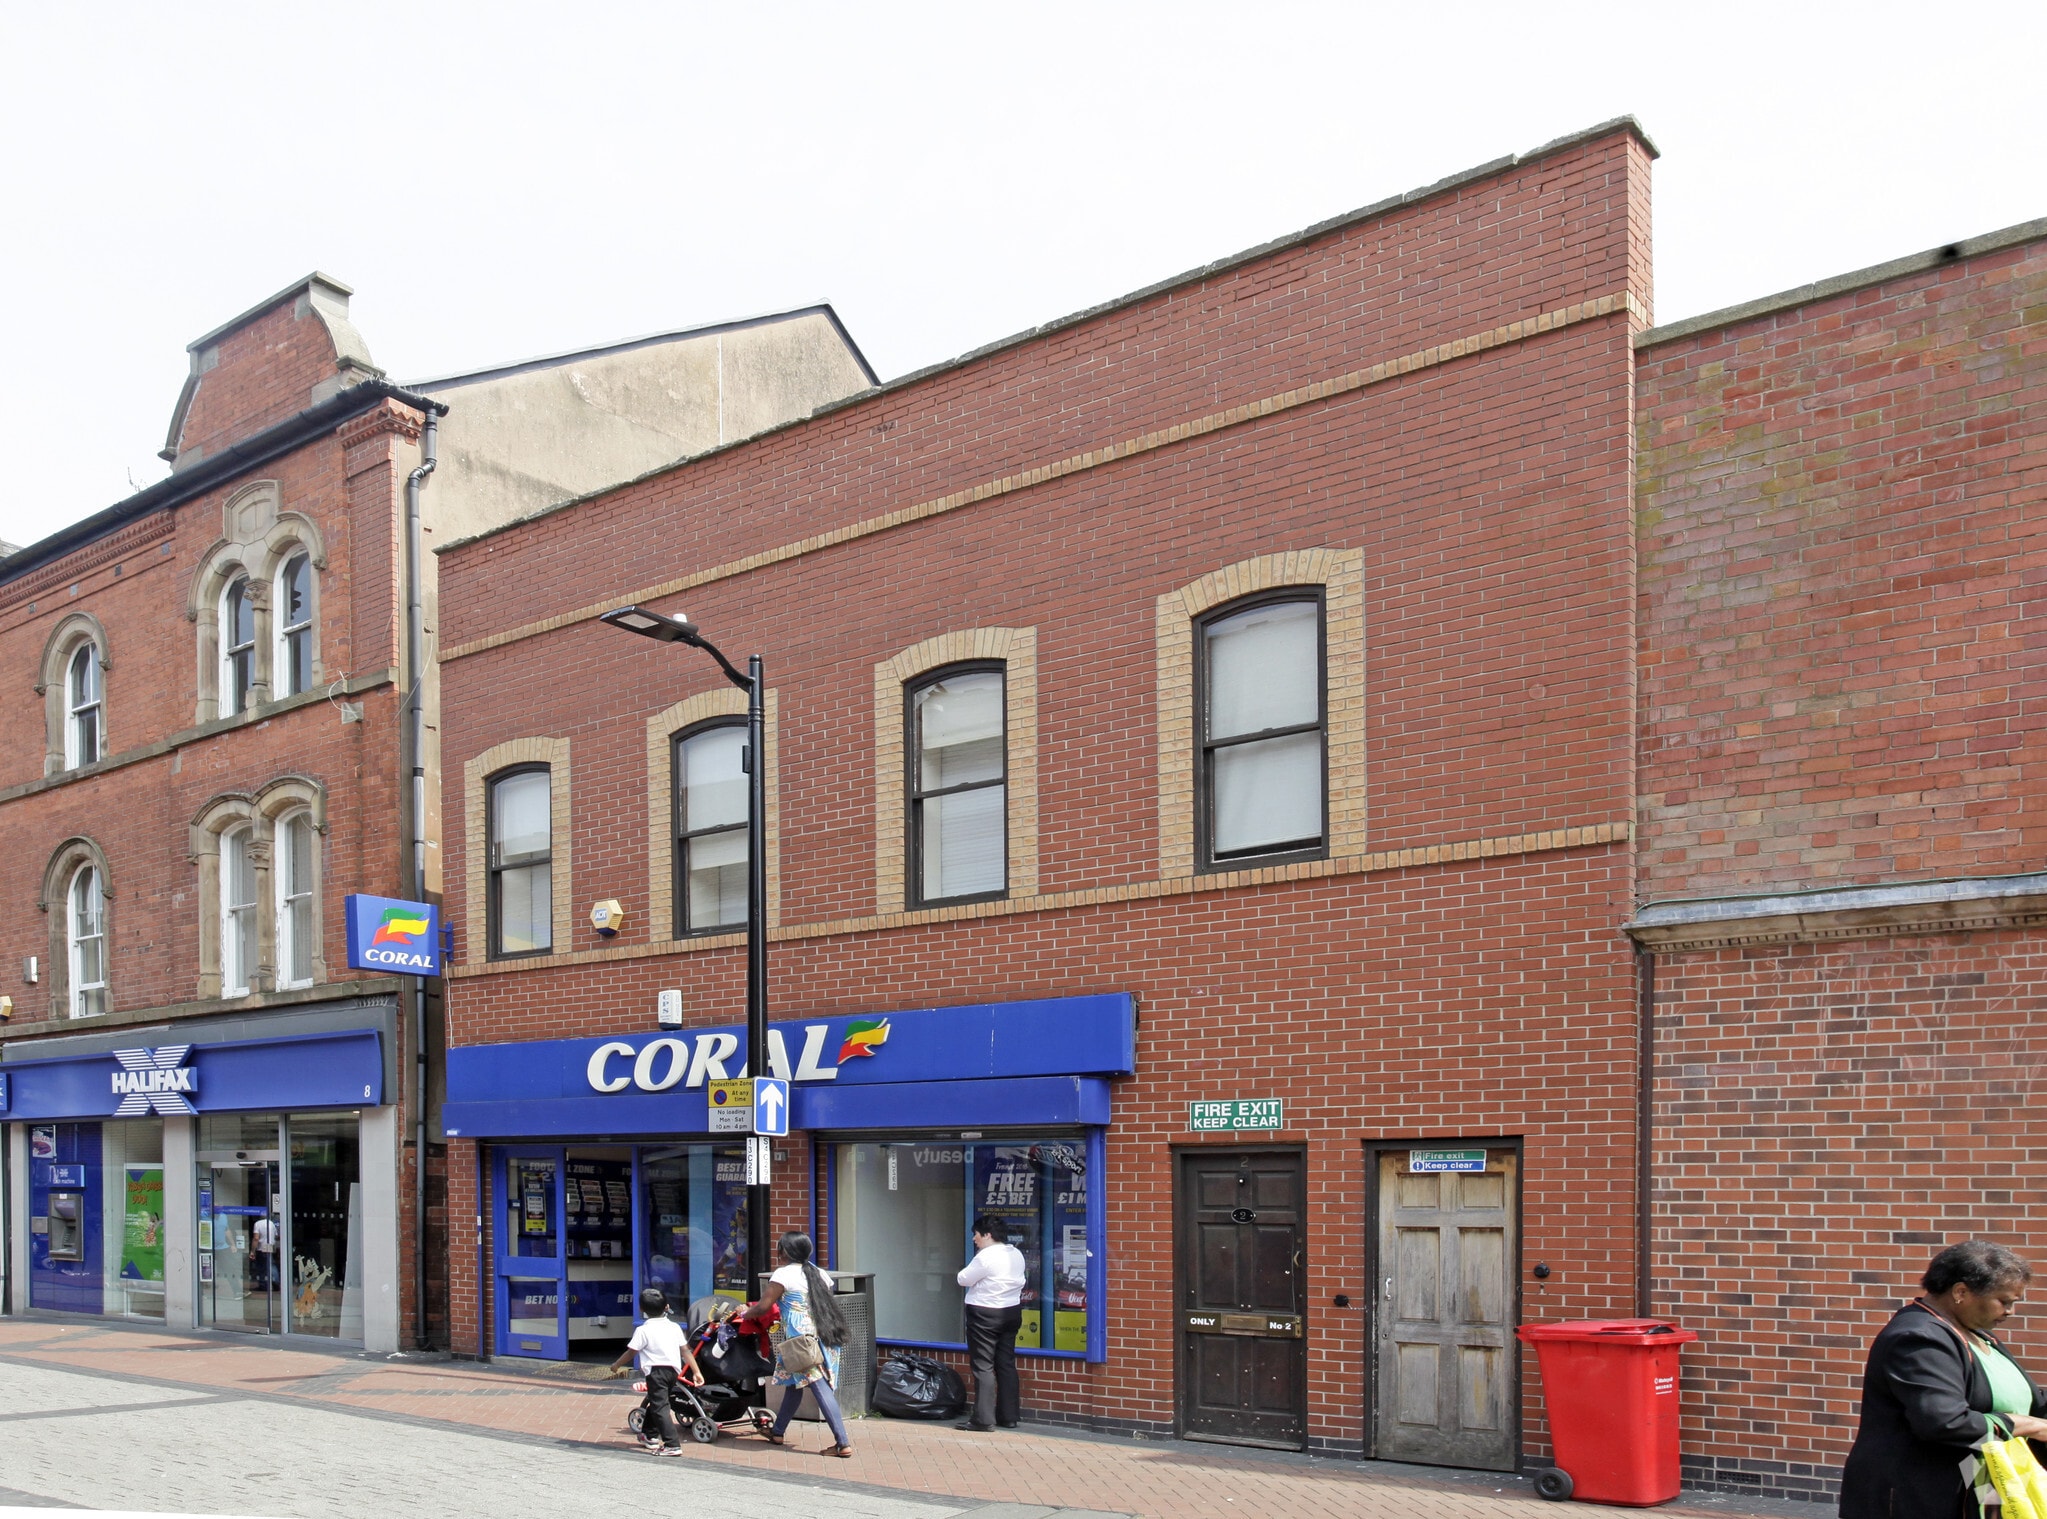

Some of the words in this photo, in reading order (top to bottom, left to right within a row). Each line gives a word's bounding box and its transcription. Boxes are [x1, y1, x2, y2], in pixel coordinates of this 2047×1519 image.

[365, 949, 433, 968] CORAL
[587, 1025, 838, 1092] CORAL
[112, 1068, 191, 1094] HALIFAX
[364, 1085, 371, 1098] 8
[1194, 1103, 1232, 1117] FIRE
[1238, 1101, 1279, 1116] EXIT
[1193, 1118, 1228, 1128] KEEP
[1232, 1116, 1278, 1127] CLEAR
[717, 1163, 741, 1172] BEST
[1240, 1155, 1249, 1168] 2
[1425, 1162, 1448, 1170] Keep
[987, 1173, 1036, 1192] FREE
[985, 1192, 1007, 1205] £5
[1008, 1192, 1033, 1205] BET
[1057, 1192, 1075, 1204] £1
[1239, 1211, 1246, 1220] 2
[525, 1295, 544, 1305] BET
[1190, 1317, 1216, 1326] ONLY
[1269, 1321, 1283, 1330] No
[1285, 1322, 1292, 1330] 2
